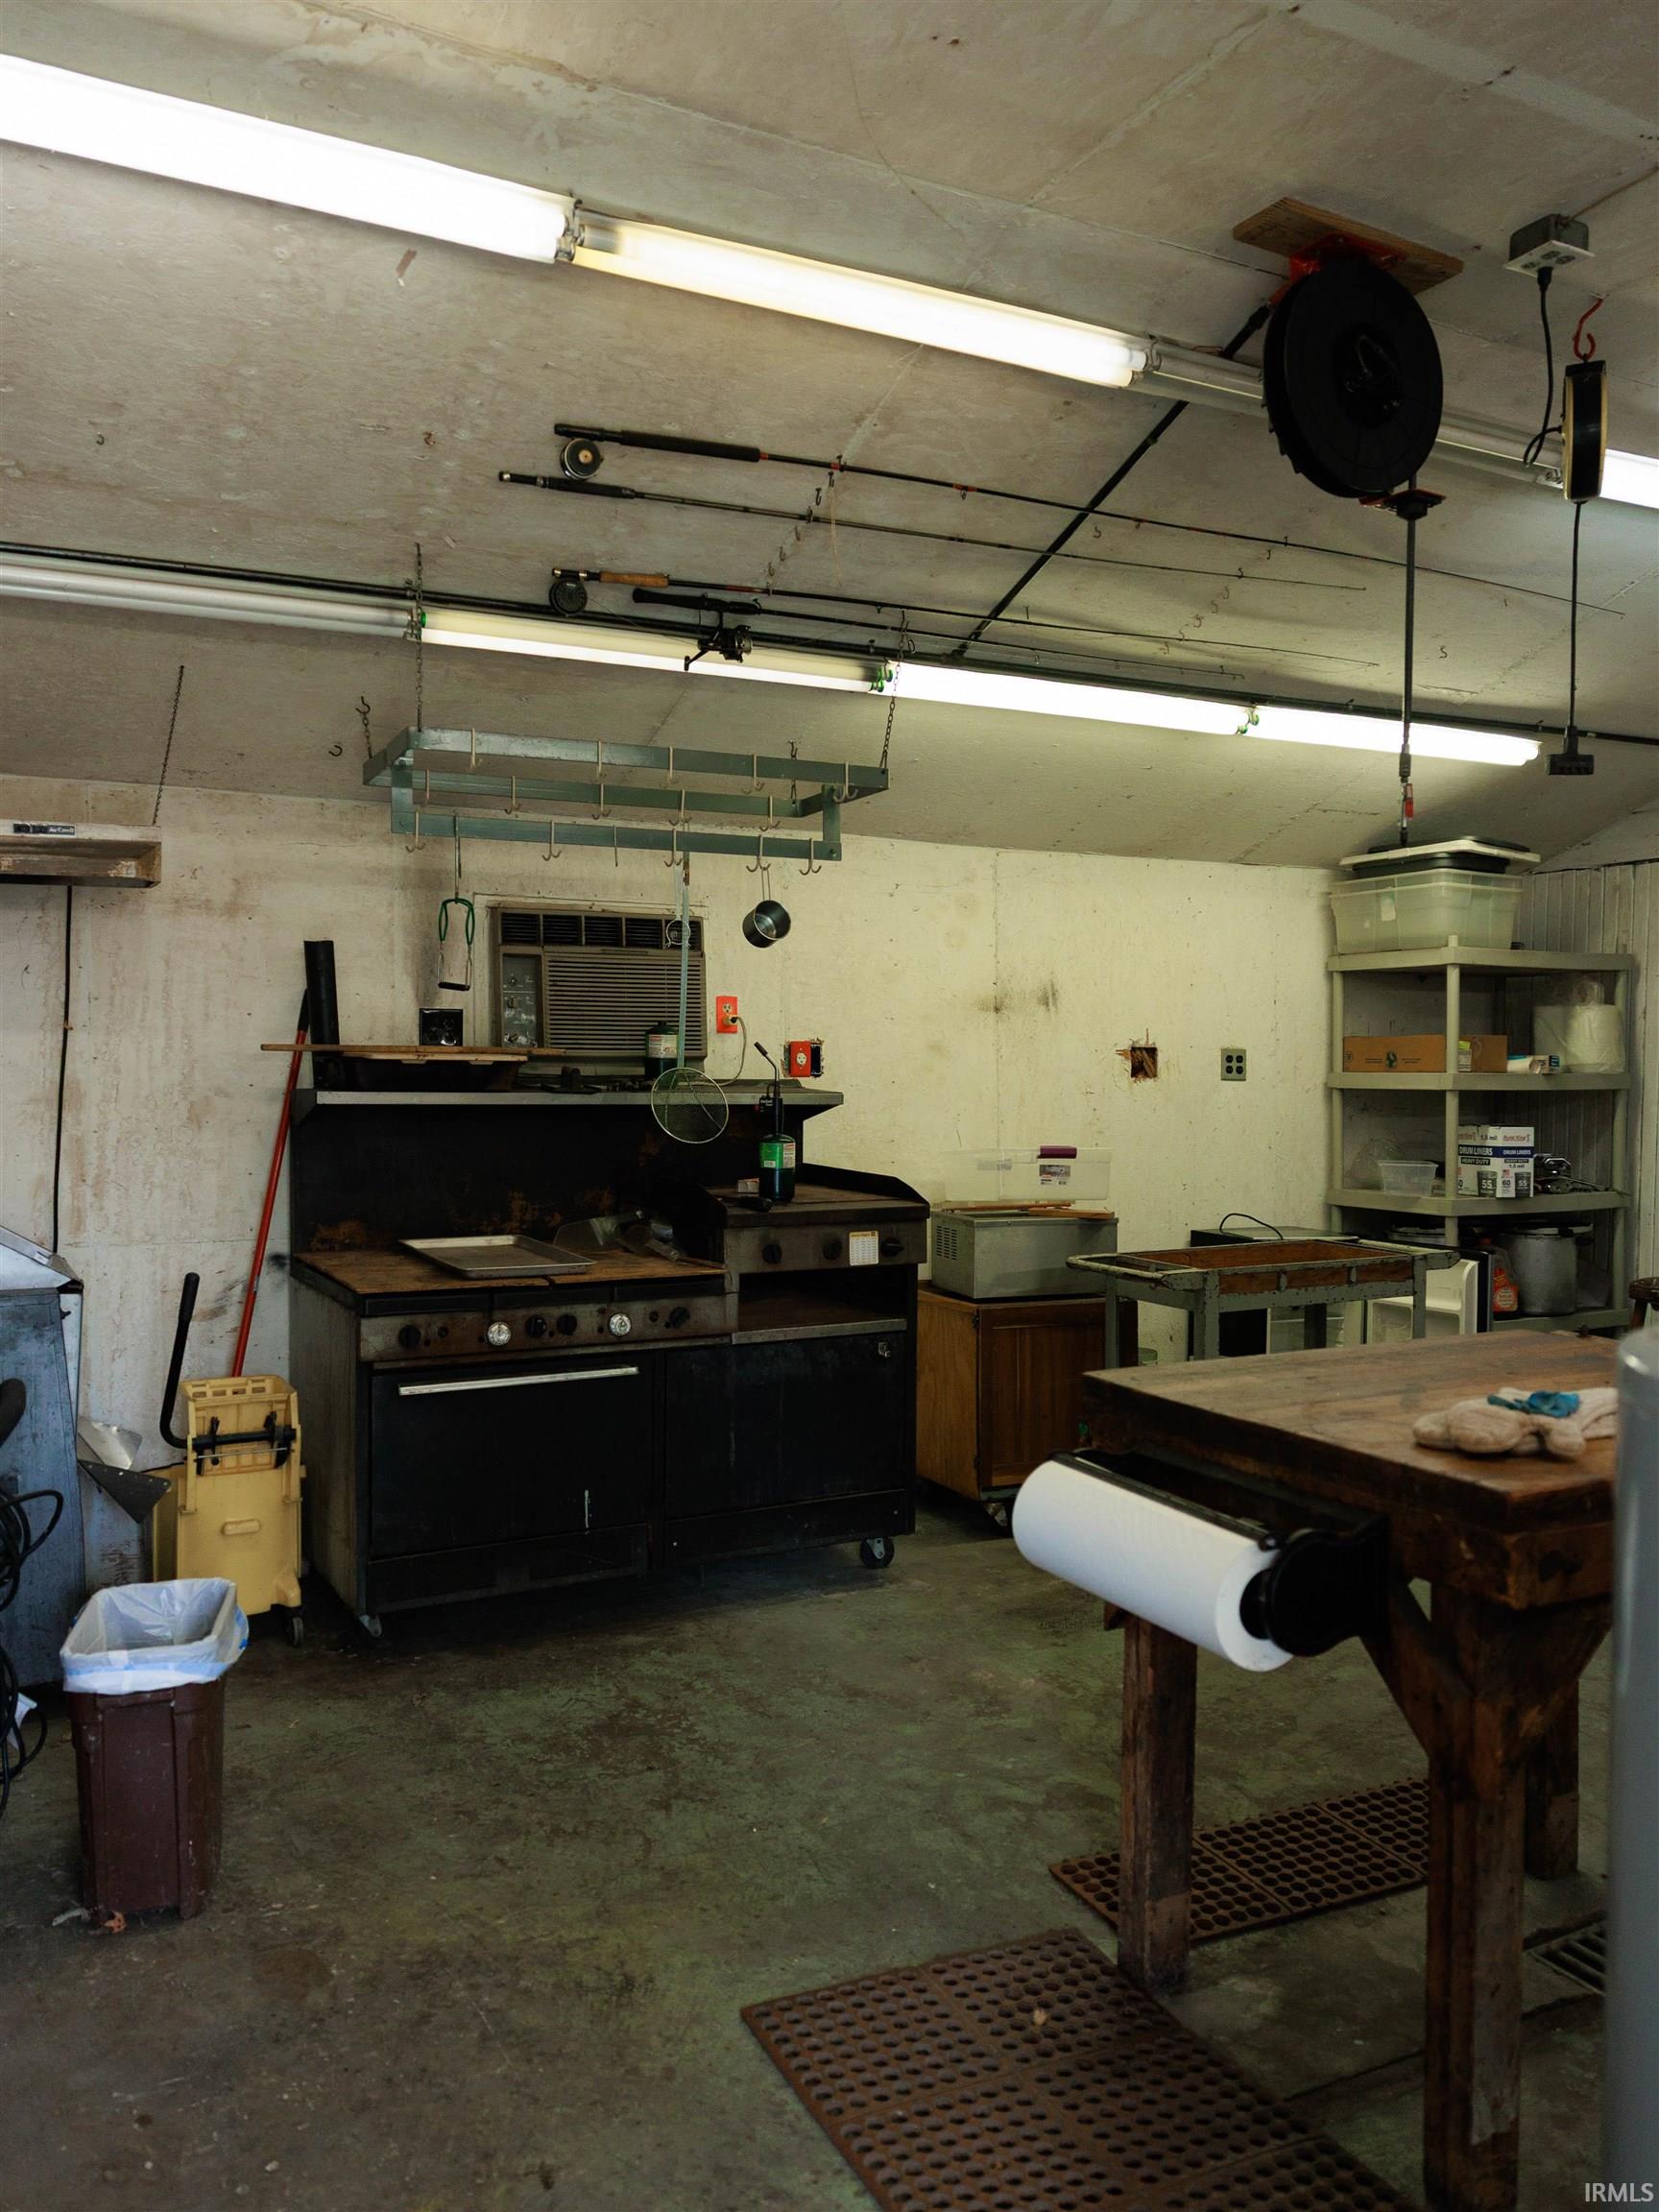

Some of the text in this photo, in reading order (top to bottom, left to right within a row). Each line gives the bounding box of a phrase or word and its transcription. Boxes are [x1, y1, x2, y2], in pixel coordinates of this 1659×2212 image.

[1459, 1146, 1493, 1156] DRUM LINERS
[1481, 1179, 1492, 1189] 55
